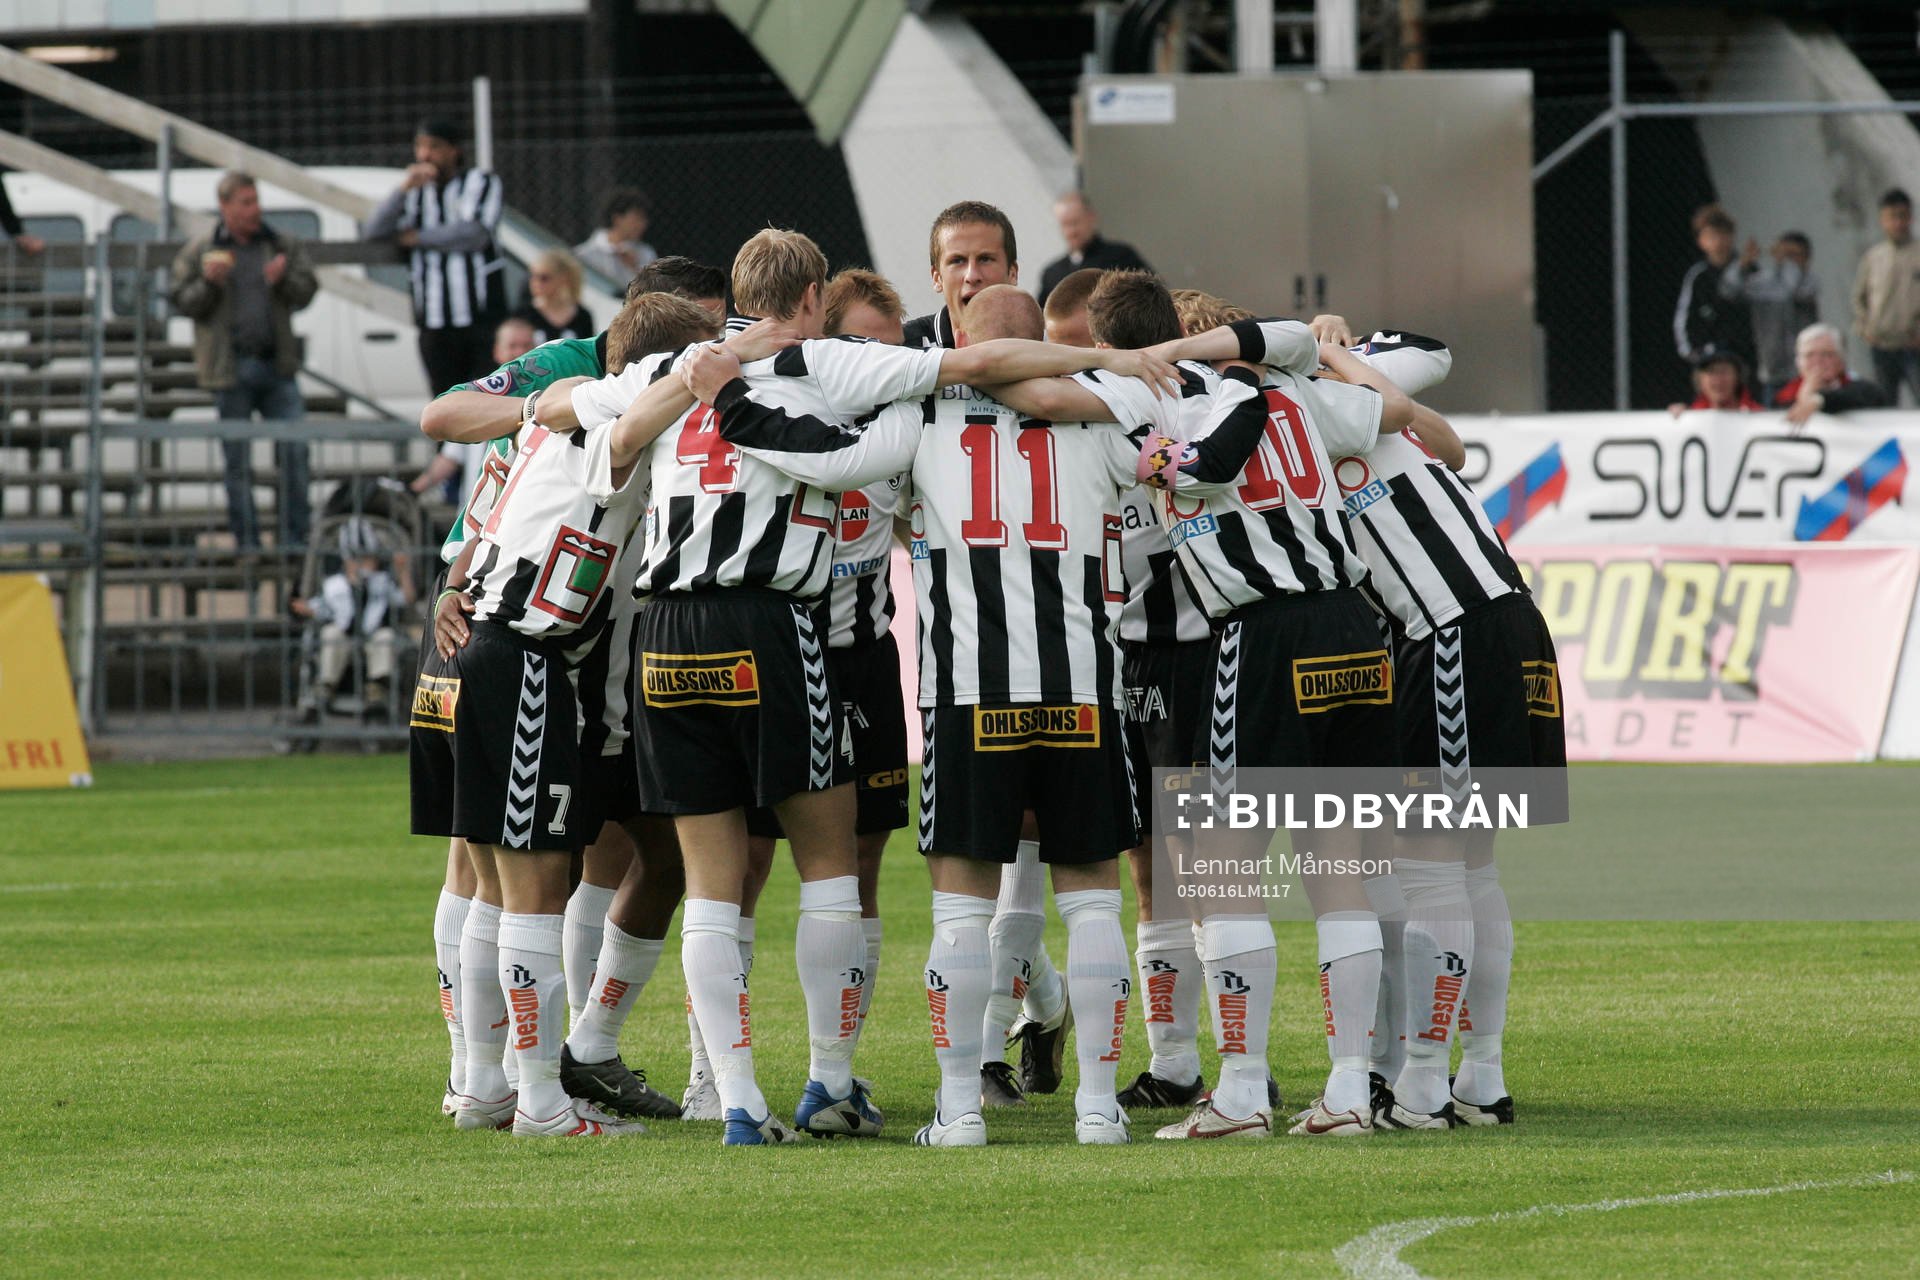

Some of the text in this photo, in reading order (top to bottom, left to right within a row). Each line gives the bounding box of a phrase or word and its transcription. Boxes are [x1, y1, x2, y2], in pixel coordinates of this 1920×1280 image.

[676, 401, 742, 495] 4
[1236, 389, 1327, 511] 10
[1589, 435, 1827, 520] SWEP
[840, 508, 869, 521] LAN
[959, 423, 1068, 551] 11
[1518, 560, 1798, 698] PORT
[646, 666, 735, 694] OHLSSONS
[1300, 667, 1381, 698] OHLSSONS
[981, 707, 1077, 735] OHLSSONS
[1566, 709, 1757, 748] ADET
[4, 738, 65, 770] FRI
[548, 784, 571, 836] 7
[509, 988, 539, 1051] besam
[1217, 993, 1248, 1055] besam
[1417, 975, 1464, 1043] besam
